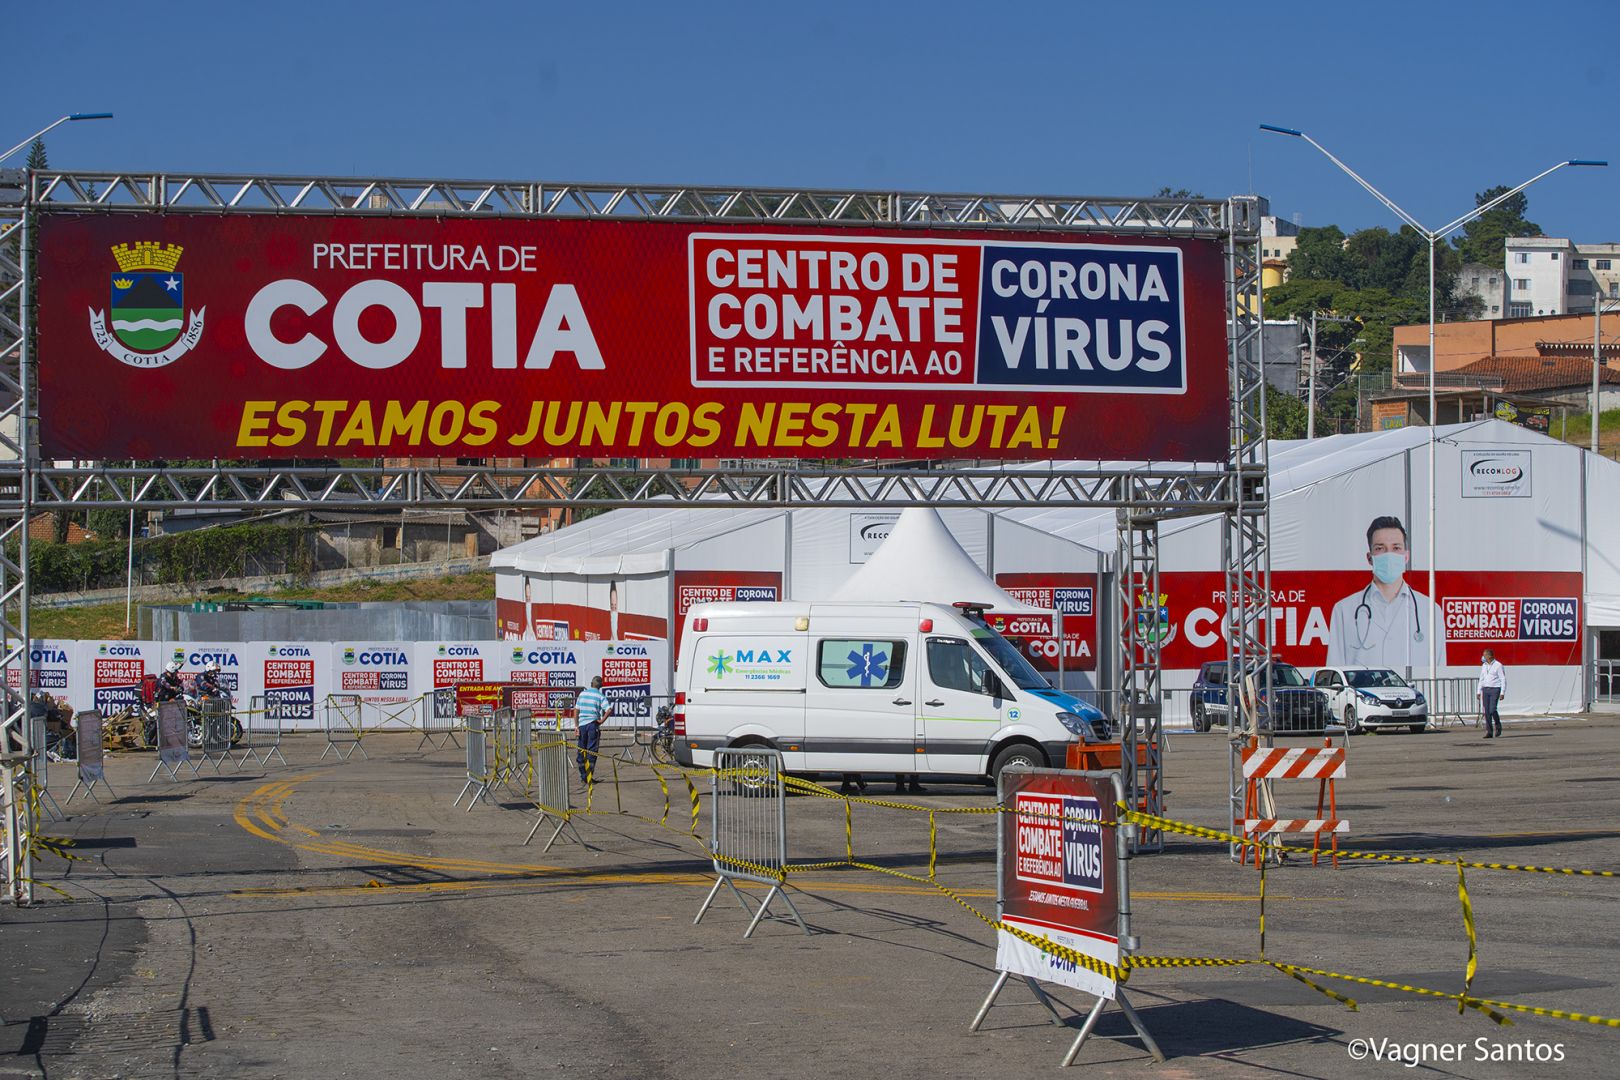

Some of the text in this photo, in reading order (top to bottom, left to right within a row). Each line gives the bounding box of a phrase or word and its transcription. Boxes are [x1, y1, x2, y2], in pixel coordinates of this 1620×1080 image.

[313, 244, 537, 272] PREFEITURA DE
[706, 249, 959, 293] CENTRO DE
[991, 259, 1169, 302] CORONA
[708, 293, 964, 342] COMBATE
[244, 279, 606, 371] COTIA
[93, 320, 108, 345] 1723
[186, 320, 203, 345] 1856
[991, 300, 1172, 372] VÍRUS
[123, 353, 170, 365] COTIA
[708, 341, 963, 376] E REFERÊNCIA AO
[236, 400, 1067, 449] ESTAMOS JUNTOS NESTA LUTA!
[682, 588, 732, 597] CENTRO DE
[737, 590, 774, 598] CORONA
[1055, 591, 1090, 599] CORONA
[1289, 590, 1306, 602] DE
[1446, 601, 1516, 613] CENTRO DE
[1523, 602, 1574, 615] CORONA
[1009, 622, 1050, 633] COTIA
[1446, 614, 1516, 628] COMBATE
[1523, 614, 1574, 636] VÍRUS
[1447, 630, 1452, 638] E
[1504, 630, 1515, 638] AO
[18, 650, 68, 663] OTIA
[109, 647, 141, 655] COTIA
[279, 648, 311, 656] COTIA
[448, 647, 479, 655] COTIA
[616, 647, 647, 655] COTIA
[736, 650, 791, 662] MAX
[189, 653, 239, 666] COTIA
[359, 652, 408, 665] COTIA
[528, 652, 576, 664] COTIA
[97, 669, 142, 677] COMBATE
[267, 670, 312, 678] COMBATE
[436, 669, 481, 677] COMBATE
[1019, 801, 1060, 827] CENTRO DE
[1019, 826, 1062, 858] COMBATE
[1065, 831, 1101, 879] VÍRUS
[1018, 857, 1023, 872] E
